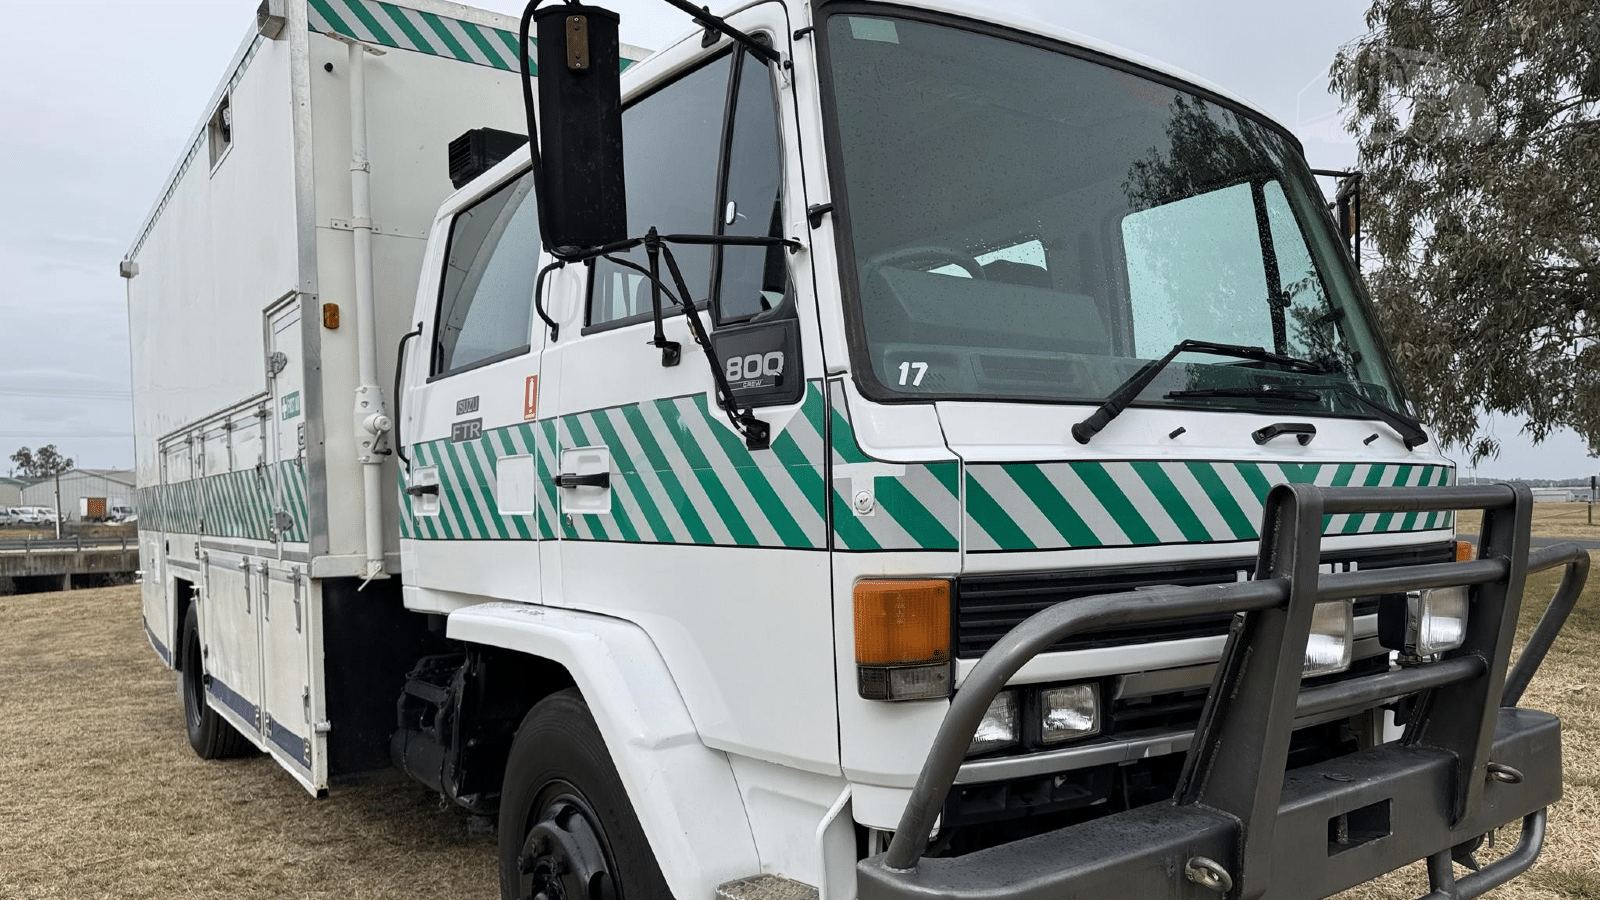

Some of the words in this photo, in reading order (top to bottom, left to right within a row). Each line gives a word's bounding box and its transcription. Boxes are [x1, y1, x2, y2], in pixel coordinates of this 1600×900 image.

[726, 351, 784, 381] 800
[898, 361, 929, 387] 17
[742, 380, 763, 388] CREW
[457, 398, 478, 414] ISUZU
[452, 421, 481, 441] FTR
